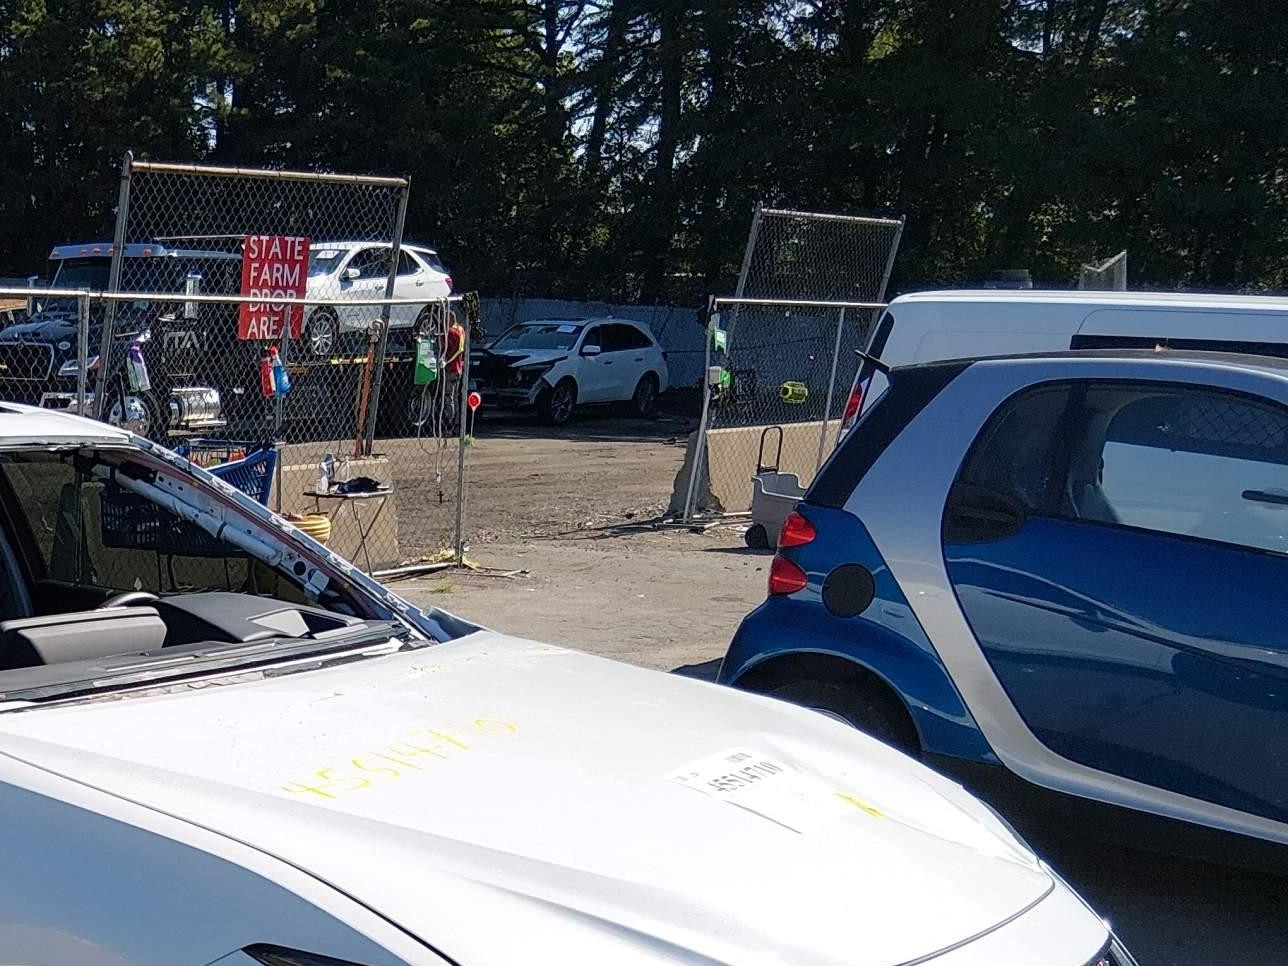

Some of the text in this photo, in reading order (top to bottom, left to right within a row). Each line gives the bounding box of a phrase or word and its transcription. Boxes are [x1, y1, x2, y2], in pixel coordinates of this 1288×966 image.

[249, 235, 305, 260] STATE
[249, 263, 301, 287] FARM
[247, 316, 293, 340] AREA
[280, 718, 517, 799] 4551470
[707, 761, 784, 793] 45514710
